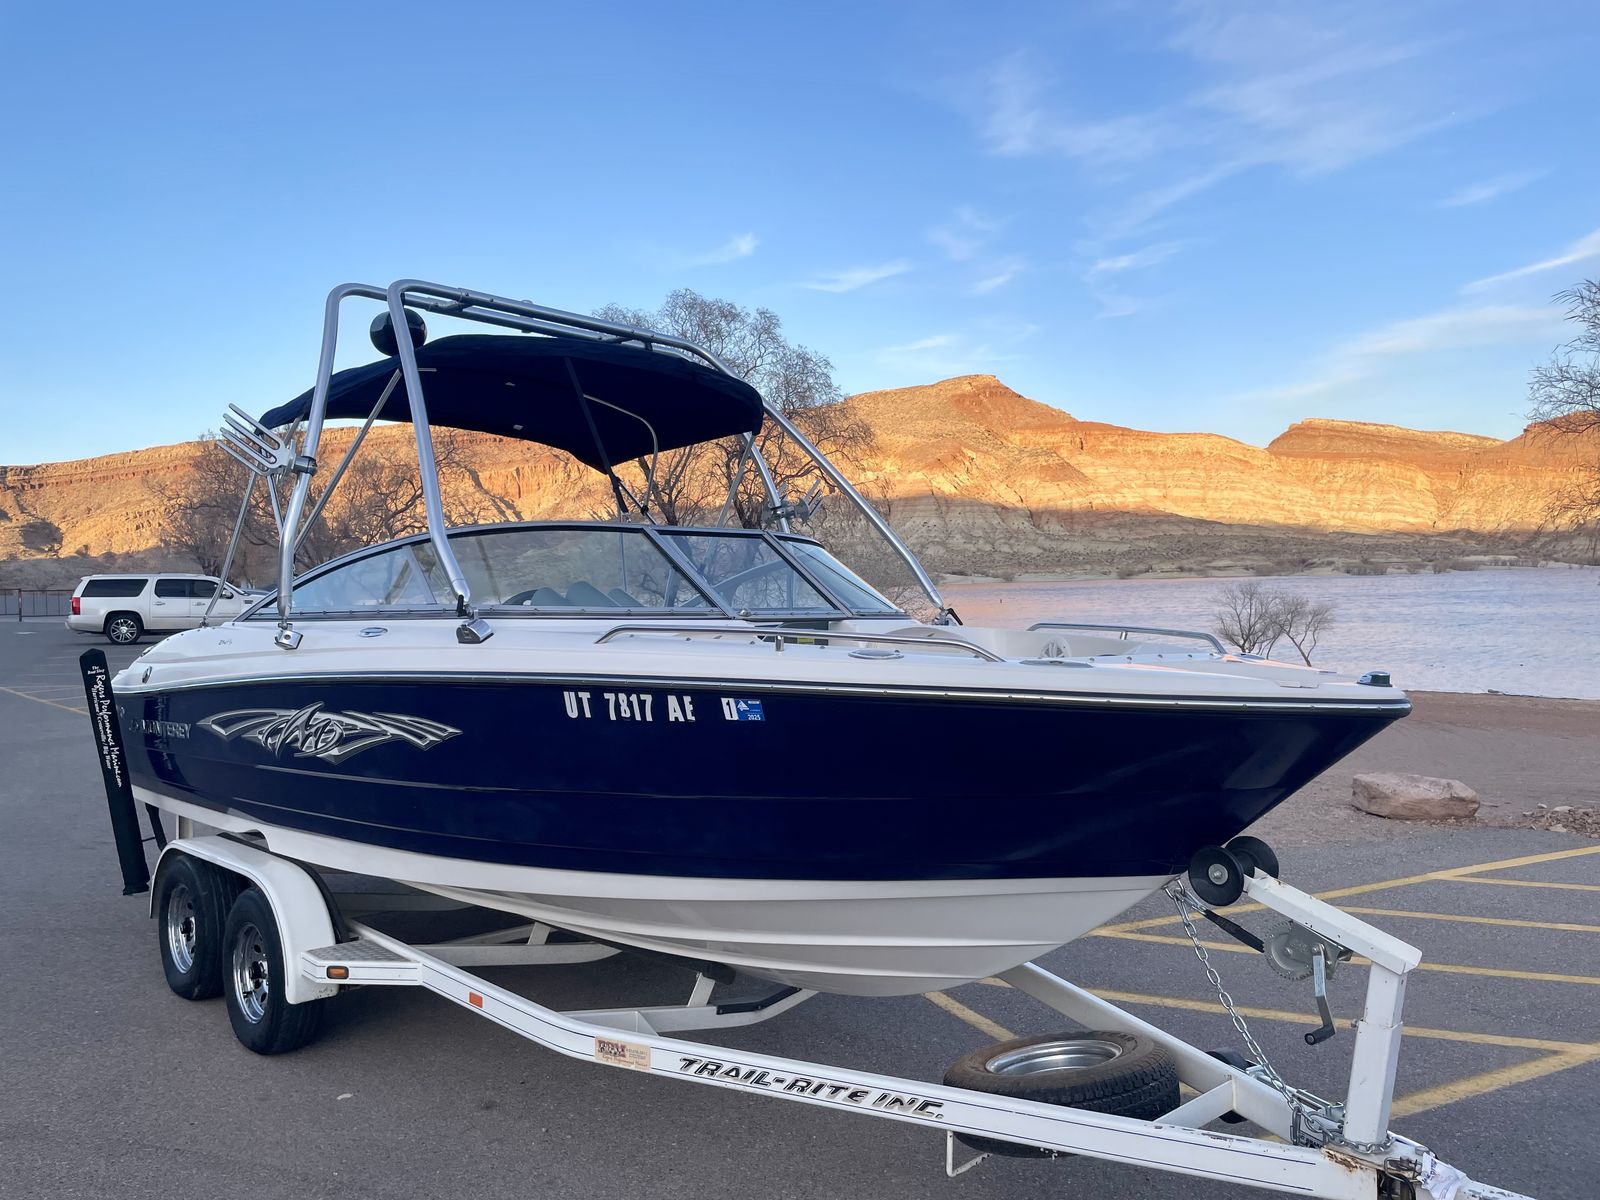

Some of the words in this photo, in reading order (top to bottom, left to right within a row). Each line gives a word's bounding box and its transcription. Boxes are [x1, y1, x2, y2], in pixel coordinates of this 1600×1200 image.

[94, 674, 106, 698] Rogers
[563, 691, 591, 719] UT
[603, 692, 653, 722] 7817
[667, 694, 696, 722] AE
[99, 699, 115, 746] Performance
[142, 719, 191, 739] MONTEREY
[679, 1056, 869, 1104] TRAIL-RITE
[871, 1092, 944, 1120] INC.
